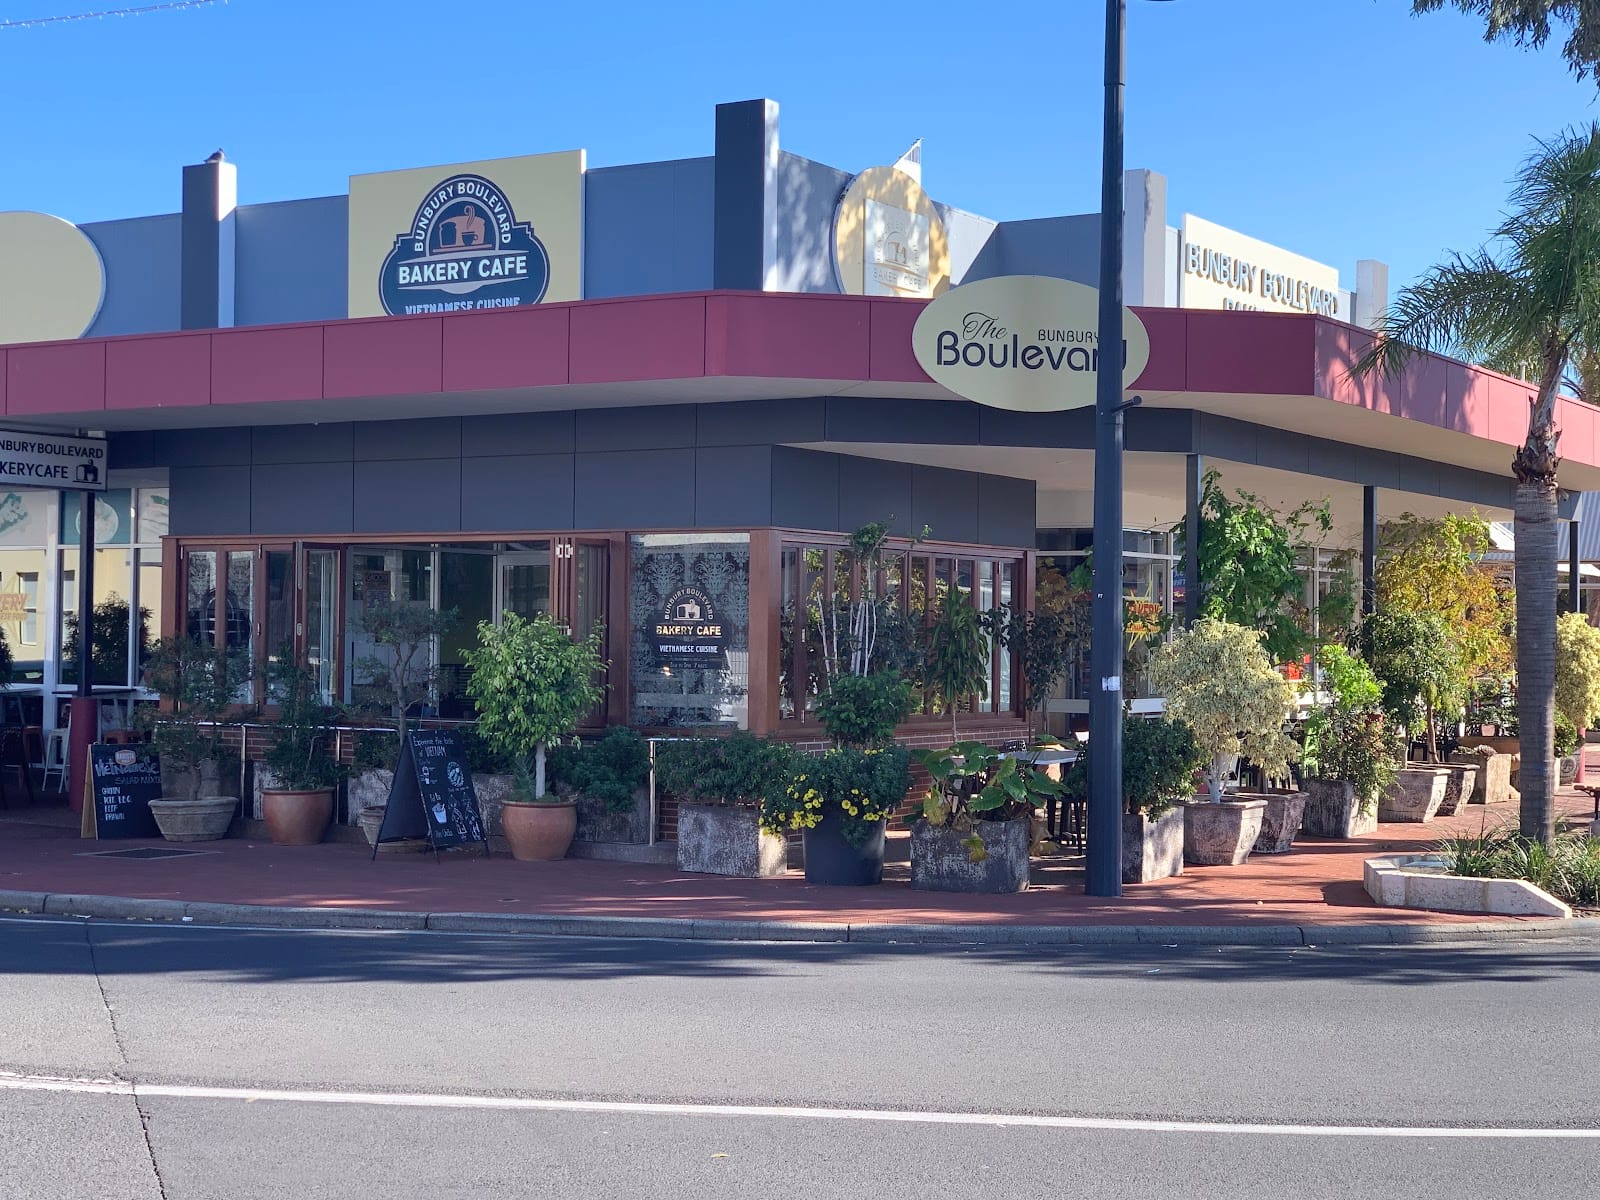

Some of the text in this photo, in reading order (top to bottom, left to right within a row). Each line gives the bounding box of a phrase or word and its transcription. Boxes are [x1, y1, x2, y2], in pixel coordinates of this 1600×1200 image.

[414, 182, 512, 252] BUNBURY BOULEVARD
[398, 255, 527, 284] BAKERY CAFE
[1185, 243, 1338, 316] BUNBURY BOULEVARD
[405, 297, 521, 315] VIETNAMESE CUISINE
[962, 311, 1008, 341] The
[664, 588, 714, 620] BUNBURY BOULEVARD
[656, 625, 722, 636] BAKERY CAFE
[659, 645, 719, 653] VIETNAMESE CUISINE
